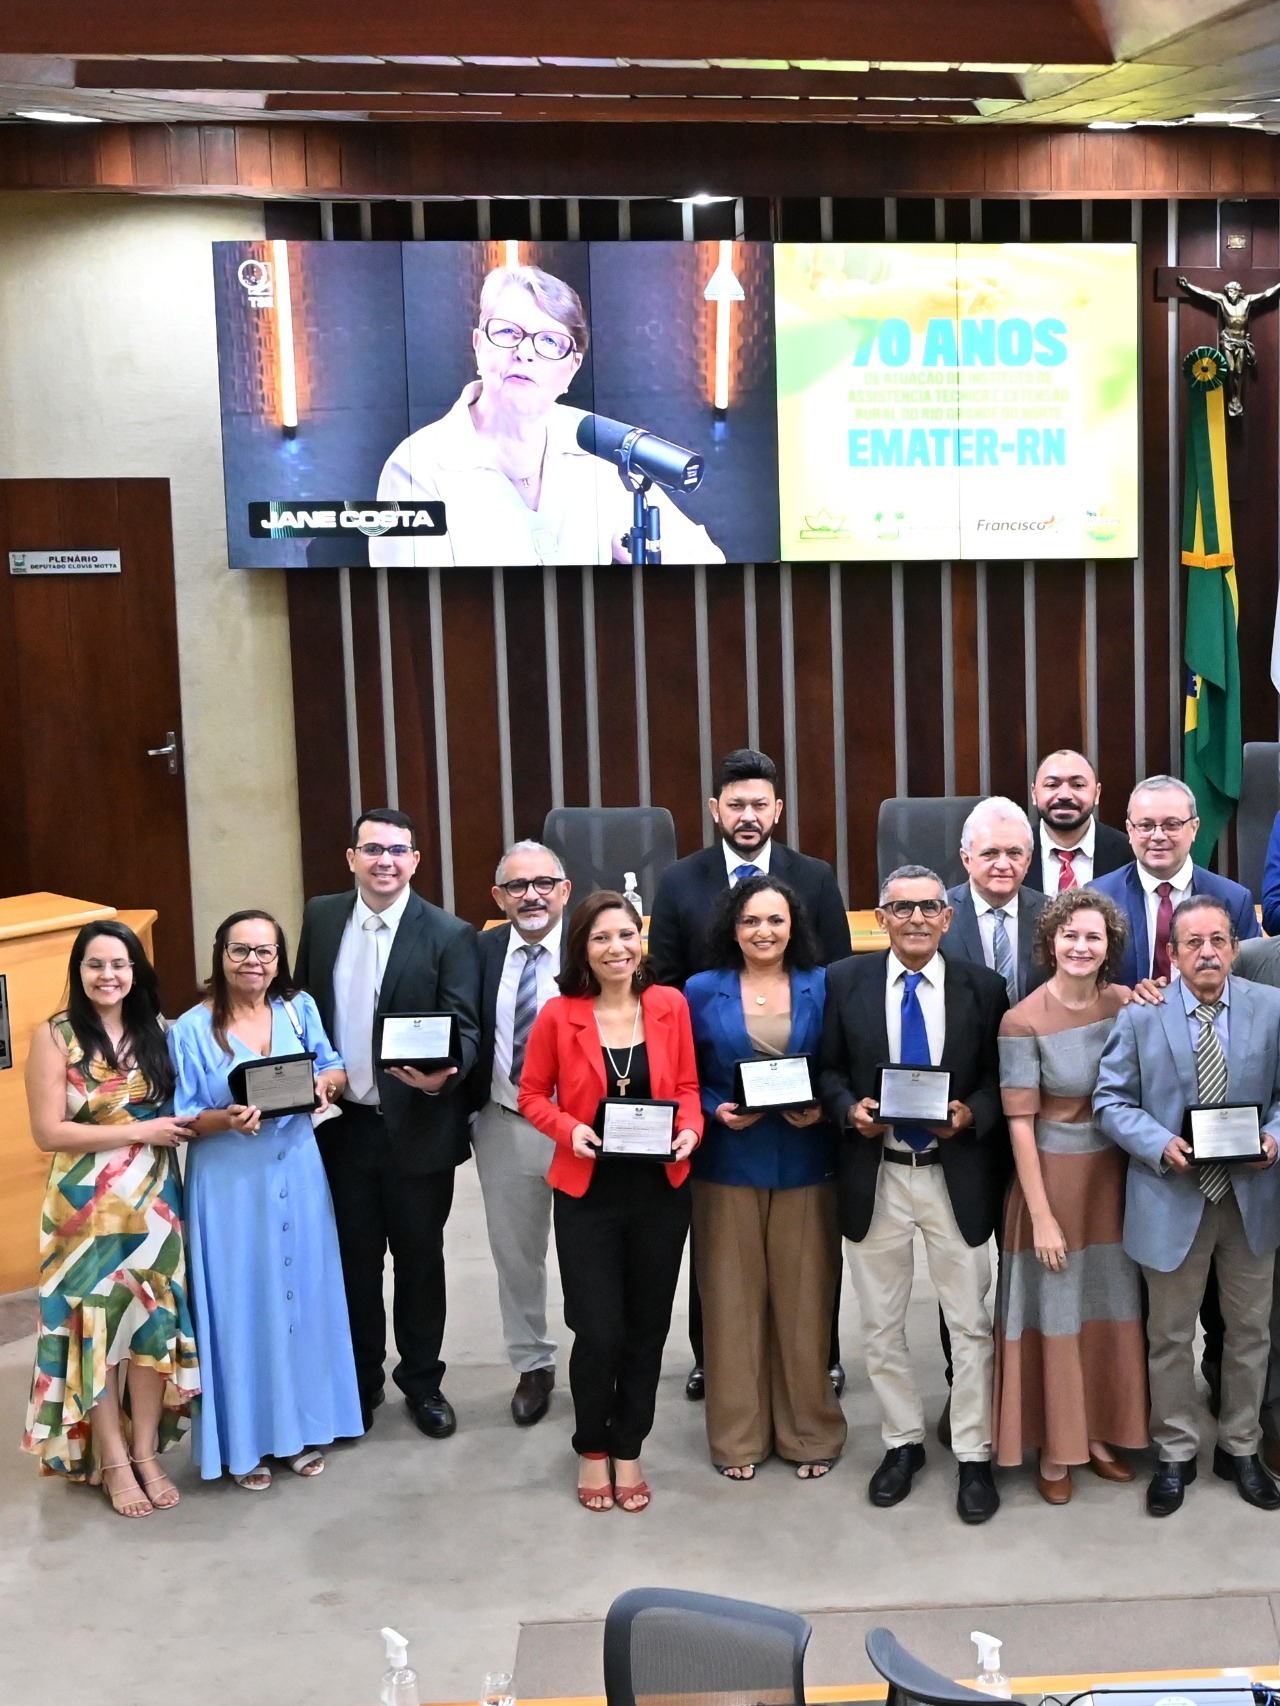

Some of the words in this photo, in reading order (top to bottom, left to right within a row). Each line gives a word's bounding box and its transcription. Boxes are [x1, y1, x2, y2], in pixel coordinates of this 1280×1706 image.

[851, 317, 912, 367] 70
[922, 317, 1069, 367] ANOS
[847, 428, 1067, 467] EMATER-RN
[260, 510, 337, 529] JANE
[339, 509, 435, 529] COSTA
[976, 518, 1046, 532] Francisco
[48, 554, 99, 563] PLENÁRIO
